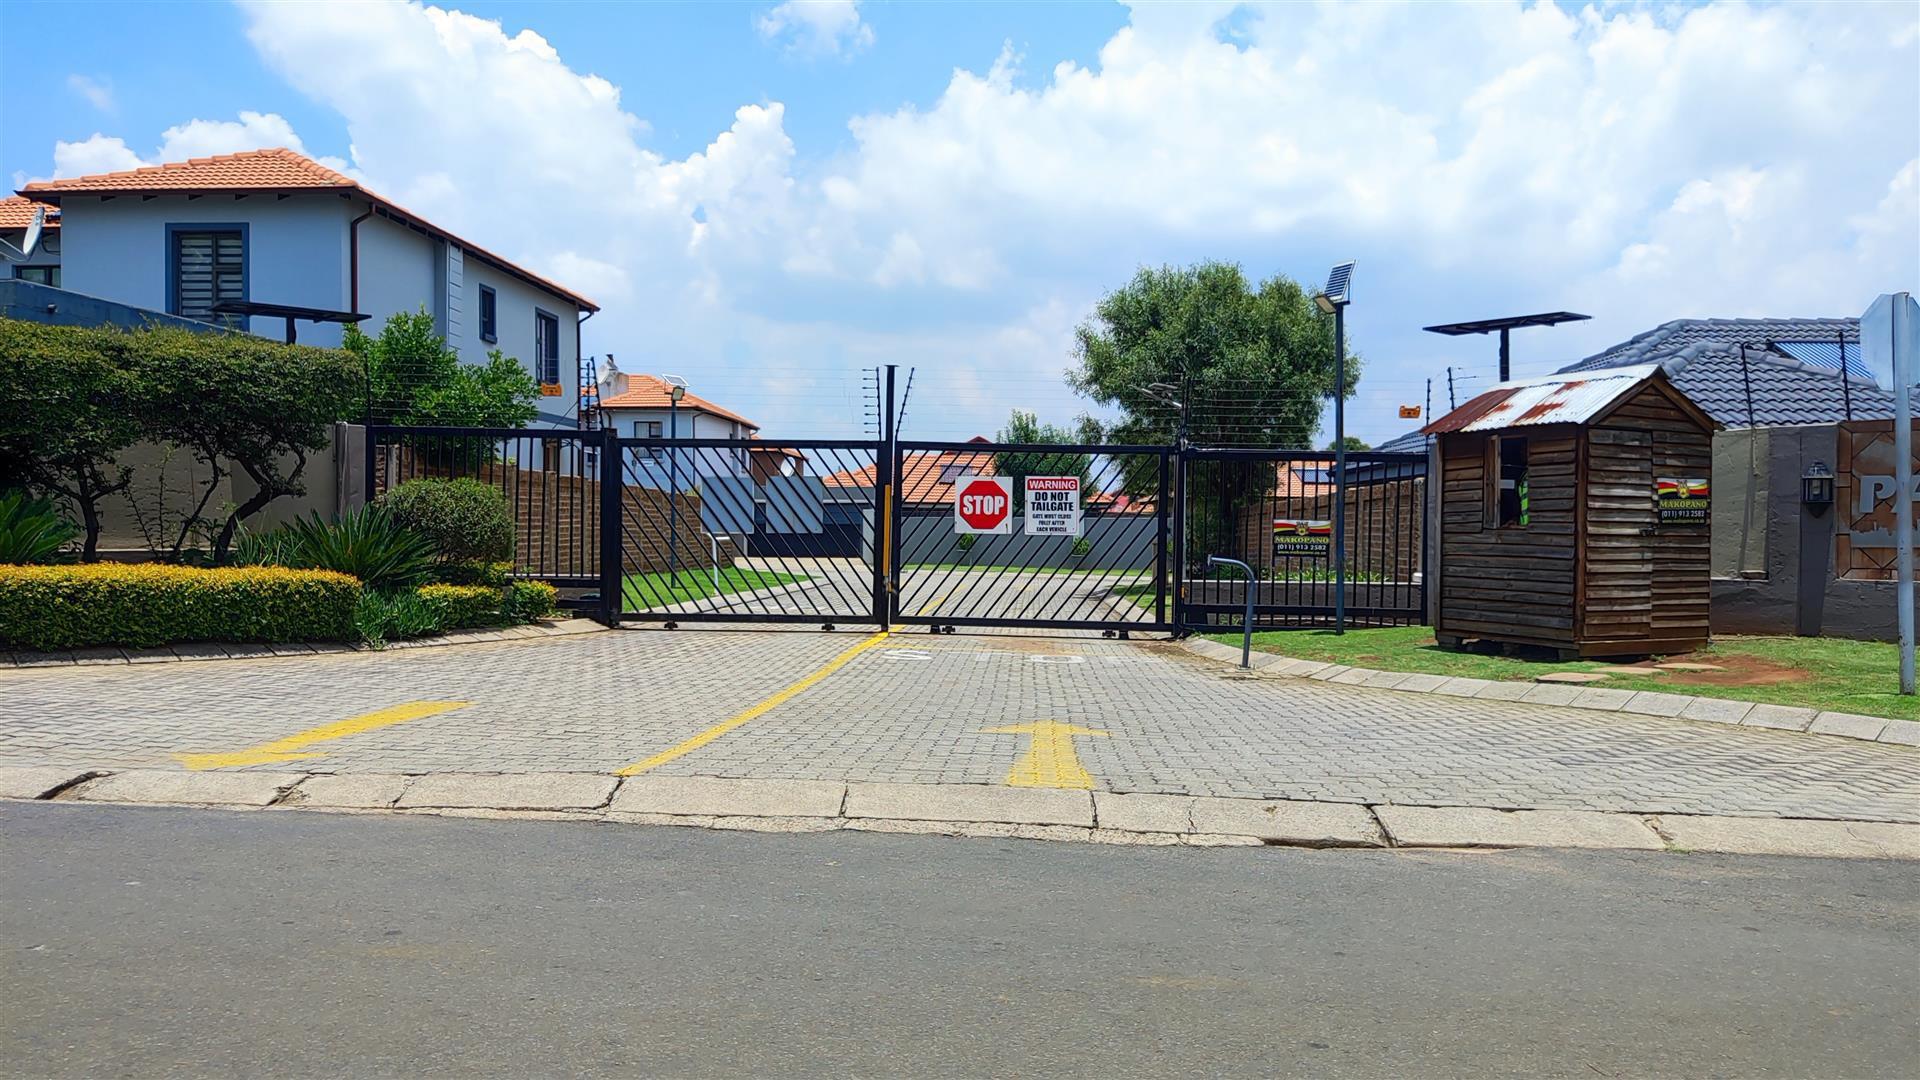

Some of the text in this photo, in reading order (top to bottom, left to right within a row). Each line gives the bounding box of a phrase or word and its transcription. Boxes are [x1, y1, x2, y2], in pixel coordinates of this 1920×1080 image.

[1029, 480, 1076, 490] WARNING
[1034, 491, 1070, 502] DO NOT
[962, 495, 1005, 516] STOP
[1031, 501, 1074, 512] TAILGATE
[1659, 500, 1707, 508] MAKOPANO
[1274, 536, 1329, 544] MAKOPANO
